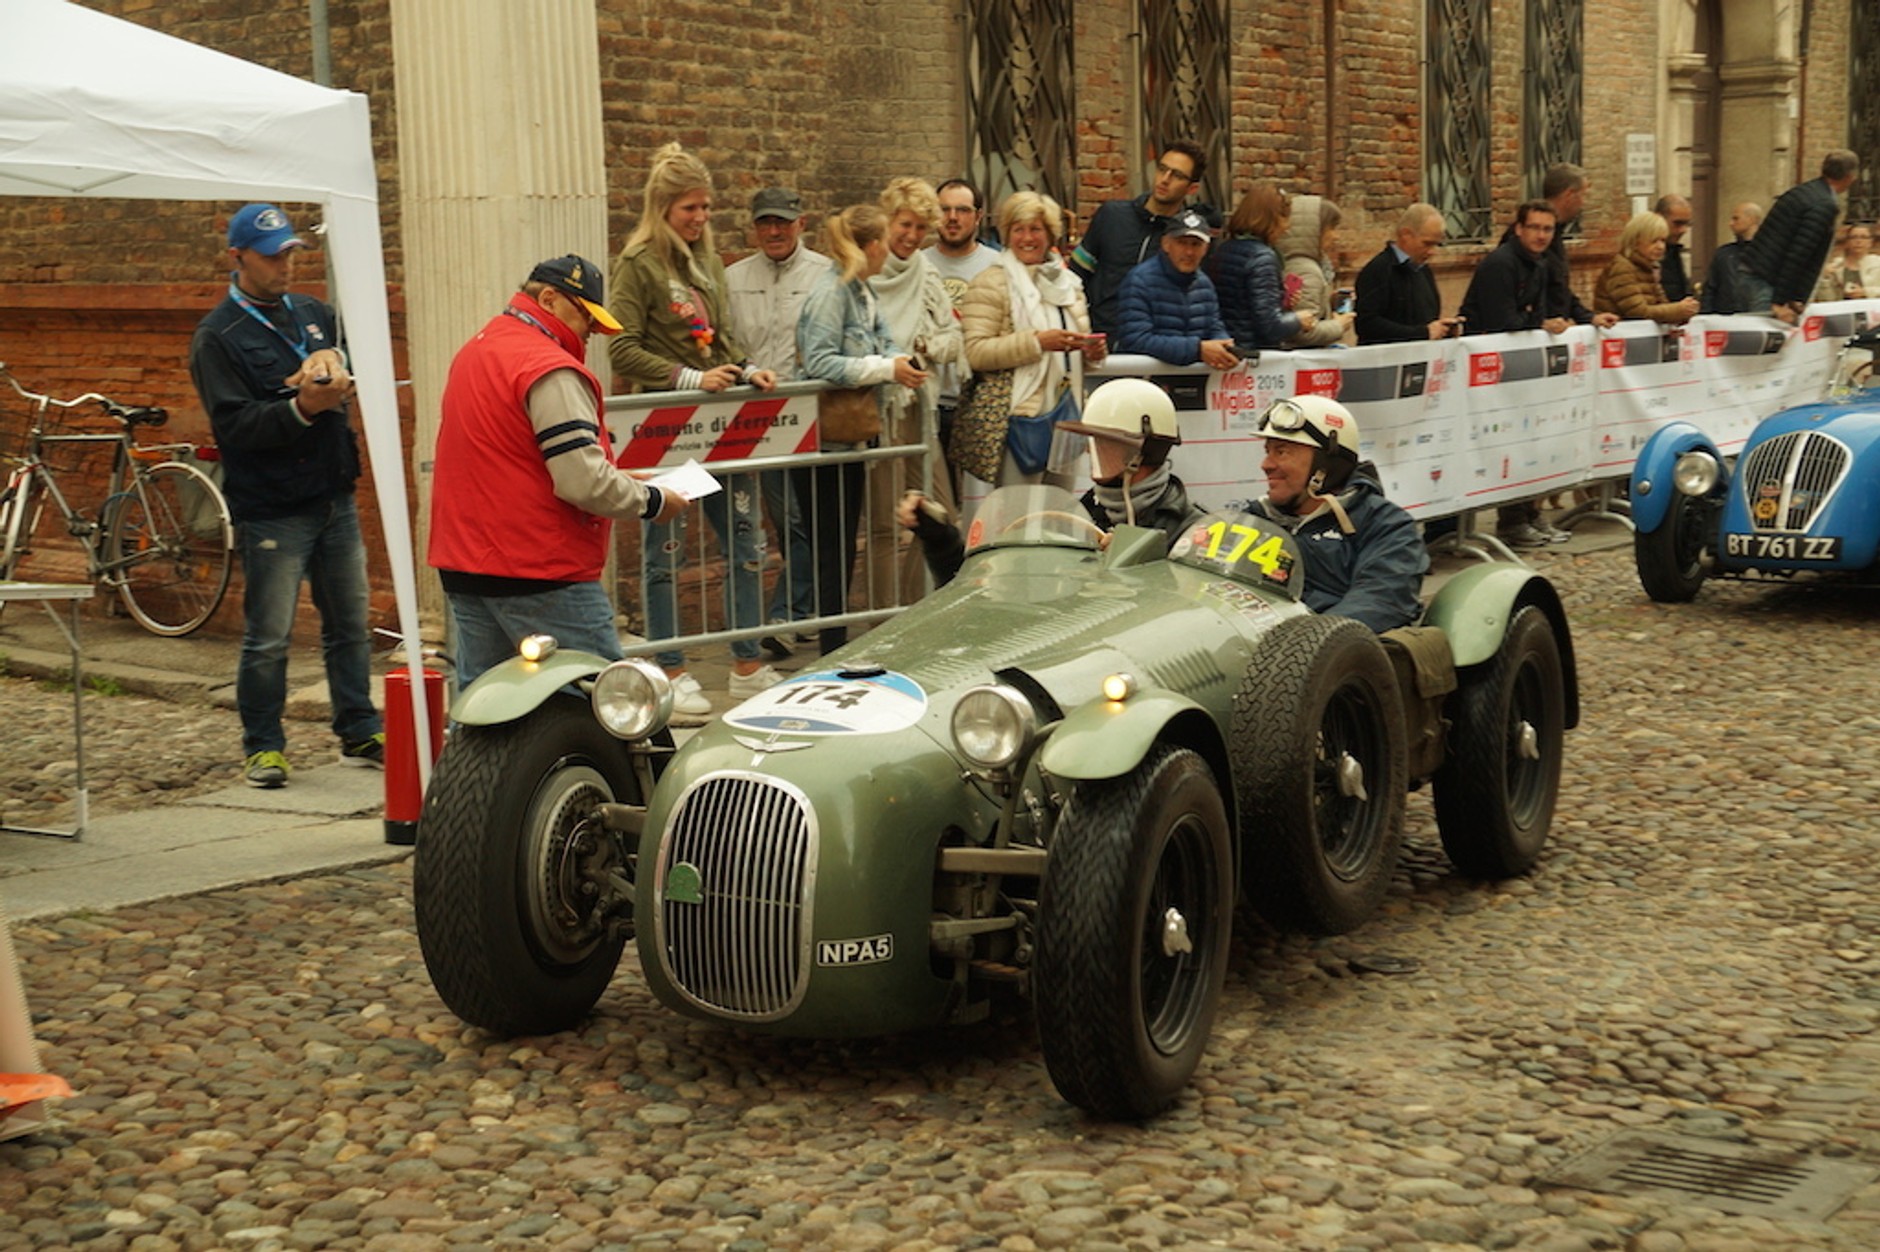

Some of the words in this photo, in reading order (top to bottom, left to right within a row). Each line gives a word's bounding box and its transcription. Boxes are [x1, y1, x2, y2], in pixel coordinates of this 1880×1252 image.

[1257, 374, 1286, 390] 2016
[1210, 390, 1255, 416] Miglia
[632, 421, 704, 440] Comune
[711, 416, 727, 432] di
[732, 413, 799, 430] Ferrara
[1205, 521, 1283, 575] 174
[1727, 534, 1754, 556] BT
[1757, 536, 1796, 558] 761
[1802, 538, 1836, 559] ZZ
[774, 684, 871, 710] 174
[822, 938, 890, 963] NPA5
